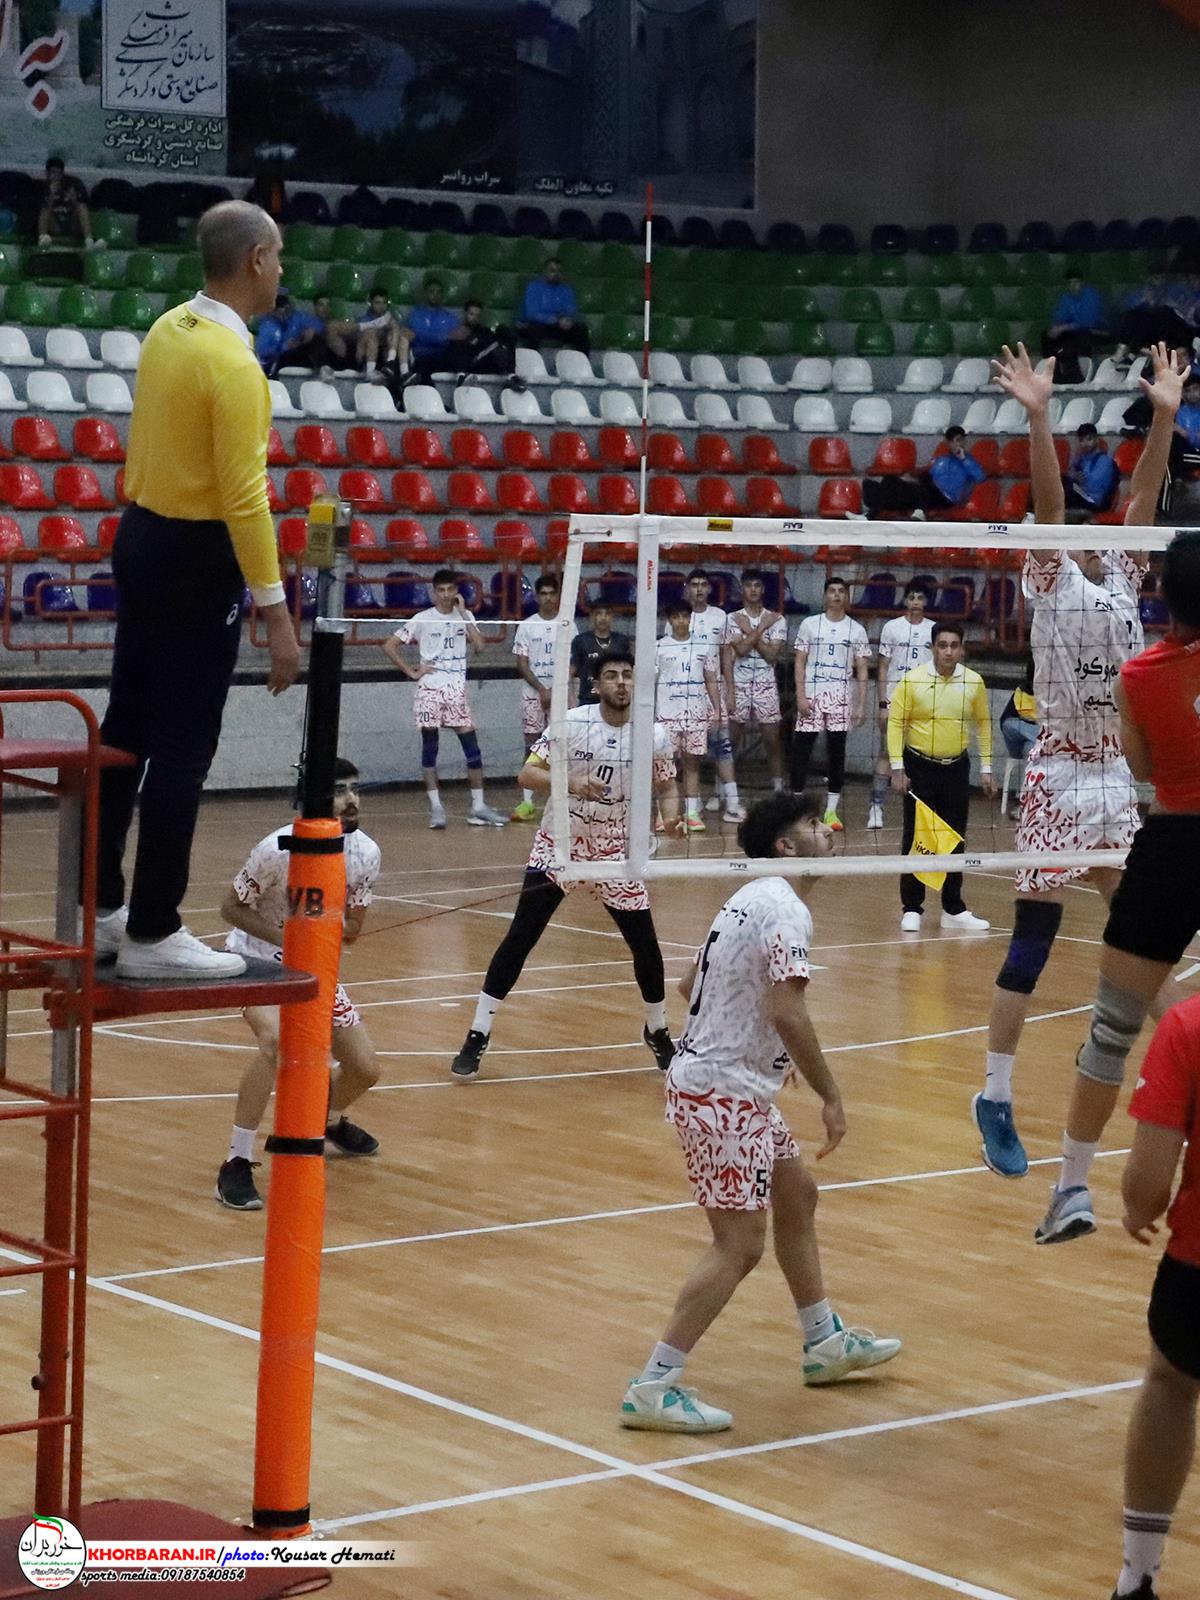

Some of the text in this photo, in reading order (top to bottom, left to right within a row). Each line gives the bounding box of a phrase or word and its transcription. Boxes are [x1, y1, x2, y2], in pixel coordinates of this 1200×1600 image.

[783, 522, 804, 530] FIVB
[988, 524, 1008, 532] FIVB
[444, 637, 455, 649] 20
[828, 643, 835, 656] 9
[912, 647, 918, 659] 6
[681, 661, 691, 673] 14
[419, 711, 430, 723] 20
[574, 750, 594, 760] FIVB
[791, 945, 808, 958] FIV
[756, 1168, 767, 1198] 5
